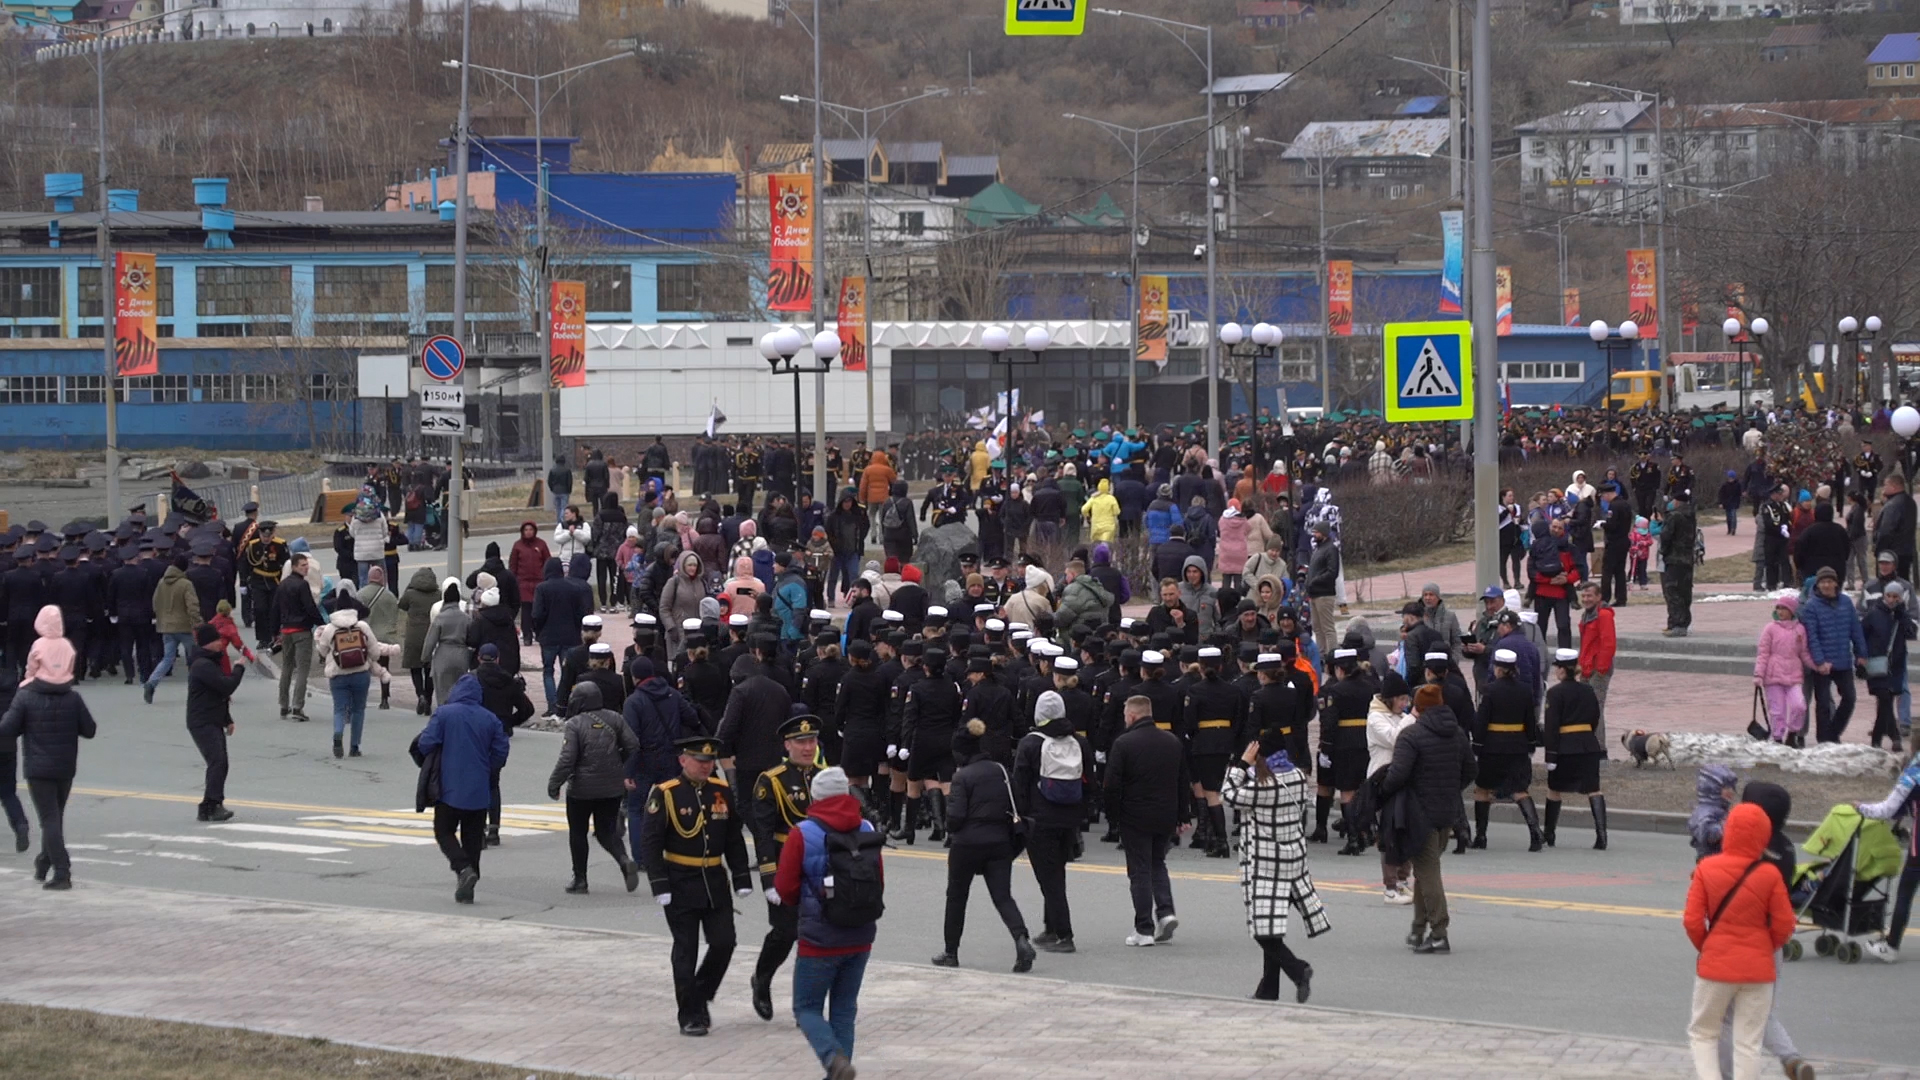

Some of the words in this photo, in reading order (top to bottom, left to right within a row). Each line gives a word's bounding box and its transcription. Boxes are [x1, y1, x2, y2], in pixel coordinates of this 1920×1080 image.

[774, 225, 781, 234] С
[784, 225, 810, 236] Днем
[773, 237, 810, 247] Победы!
[118, 298, 125, 306] С
[129, 298, 153, 307] Днем
[118, 309, 154, 317] Победы!
[553, 322, 559, 330] С
[559, 322, 582, 331] Днем
[553, 332, 583, 340] Победы!
